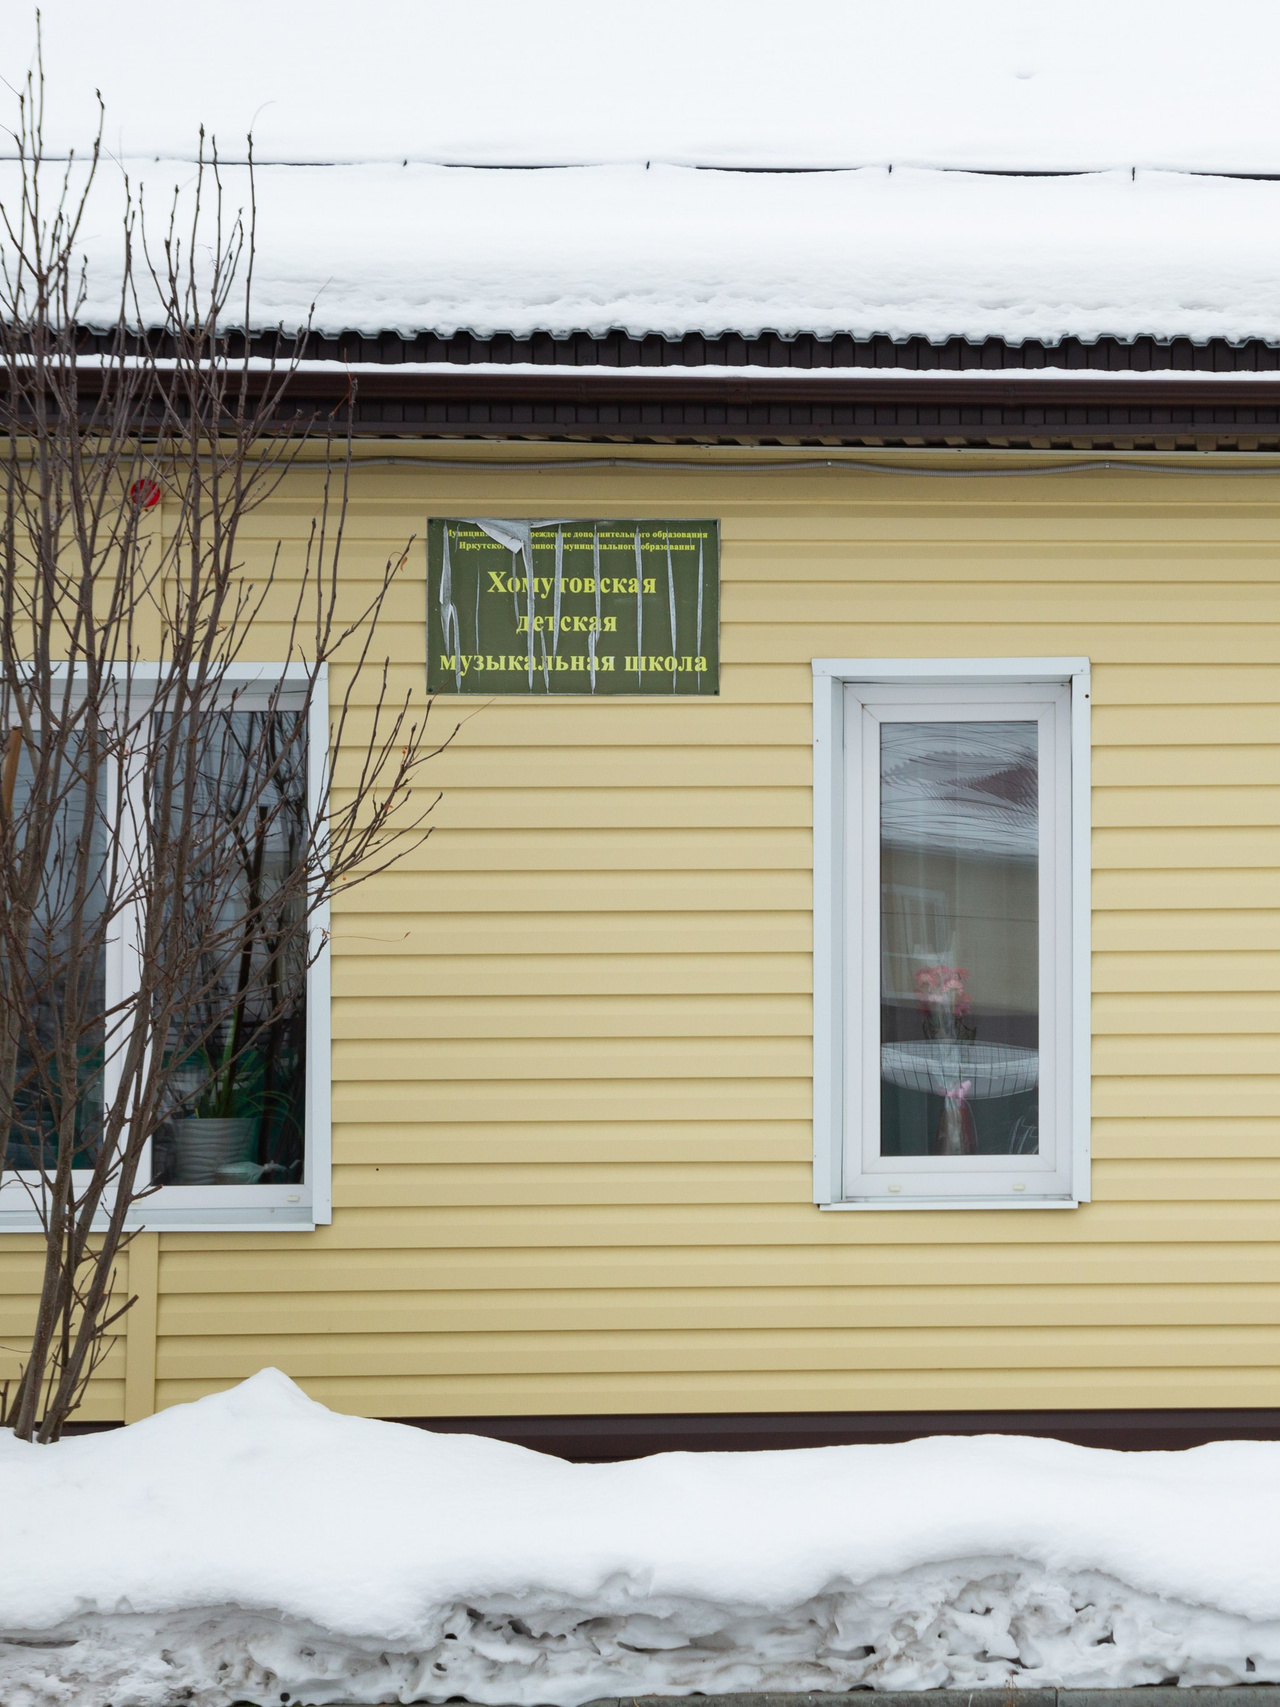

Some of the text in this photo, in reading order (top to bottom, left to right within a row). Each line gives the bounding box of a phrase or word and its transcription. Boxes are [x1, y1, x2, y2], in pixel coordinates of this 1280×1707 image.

[652, 530, 708, 540] образования
[459, 541, 505, 551] Иркутско
[640, 542, 695, 552] образования
[487, 571, 657, 599] Хомутовская
[515, 615, 617, 634] детская
[439, 655, 708, 677] музыкальная школа
